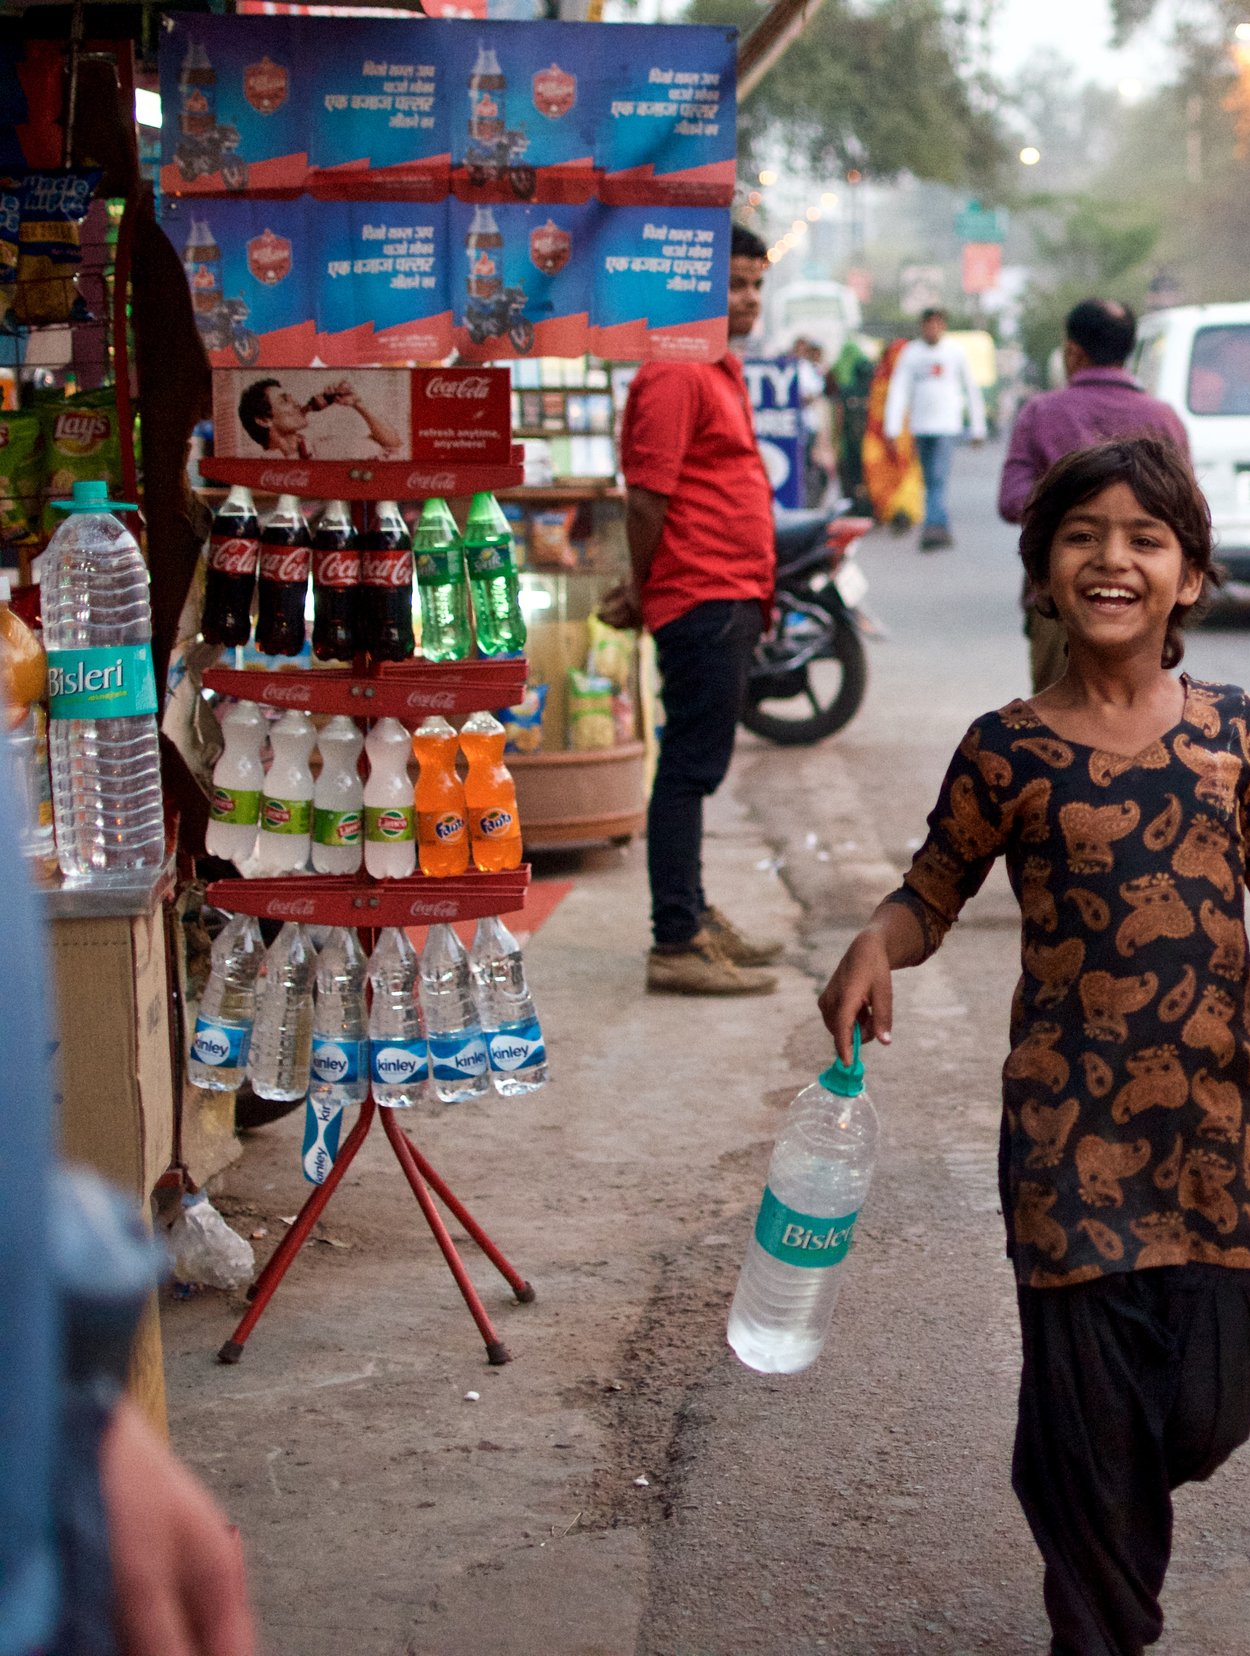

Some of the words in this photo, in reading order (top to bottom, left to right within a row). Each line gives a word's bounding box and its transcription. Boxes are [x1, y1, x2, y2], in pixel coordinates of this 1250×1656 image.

[426, 376, 492, 399] Coca-Cola
[419, 428, 455, 438] refresh
[261, 469, 309, 487] Coca-Cola
[408, 471, 456, 490] Coca-Cola
[48, 658, 123, 697] Bisleri
[263, 684, 311, 701] Coca-Cola
[407, 692, 456, 708] Coca-Cola
[480, 812, 512, 834] Fanta
[267, 900, 314, 916] Coca-Cola
[410, 900, 459, 917] Coca-Cola
[492, 1045, 530, 1060] kinley
[378, 1058, 417, 1074] kinley
